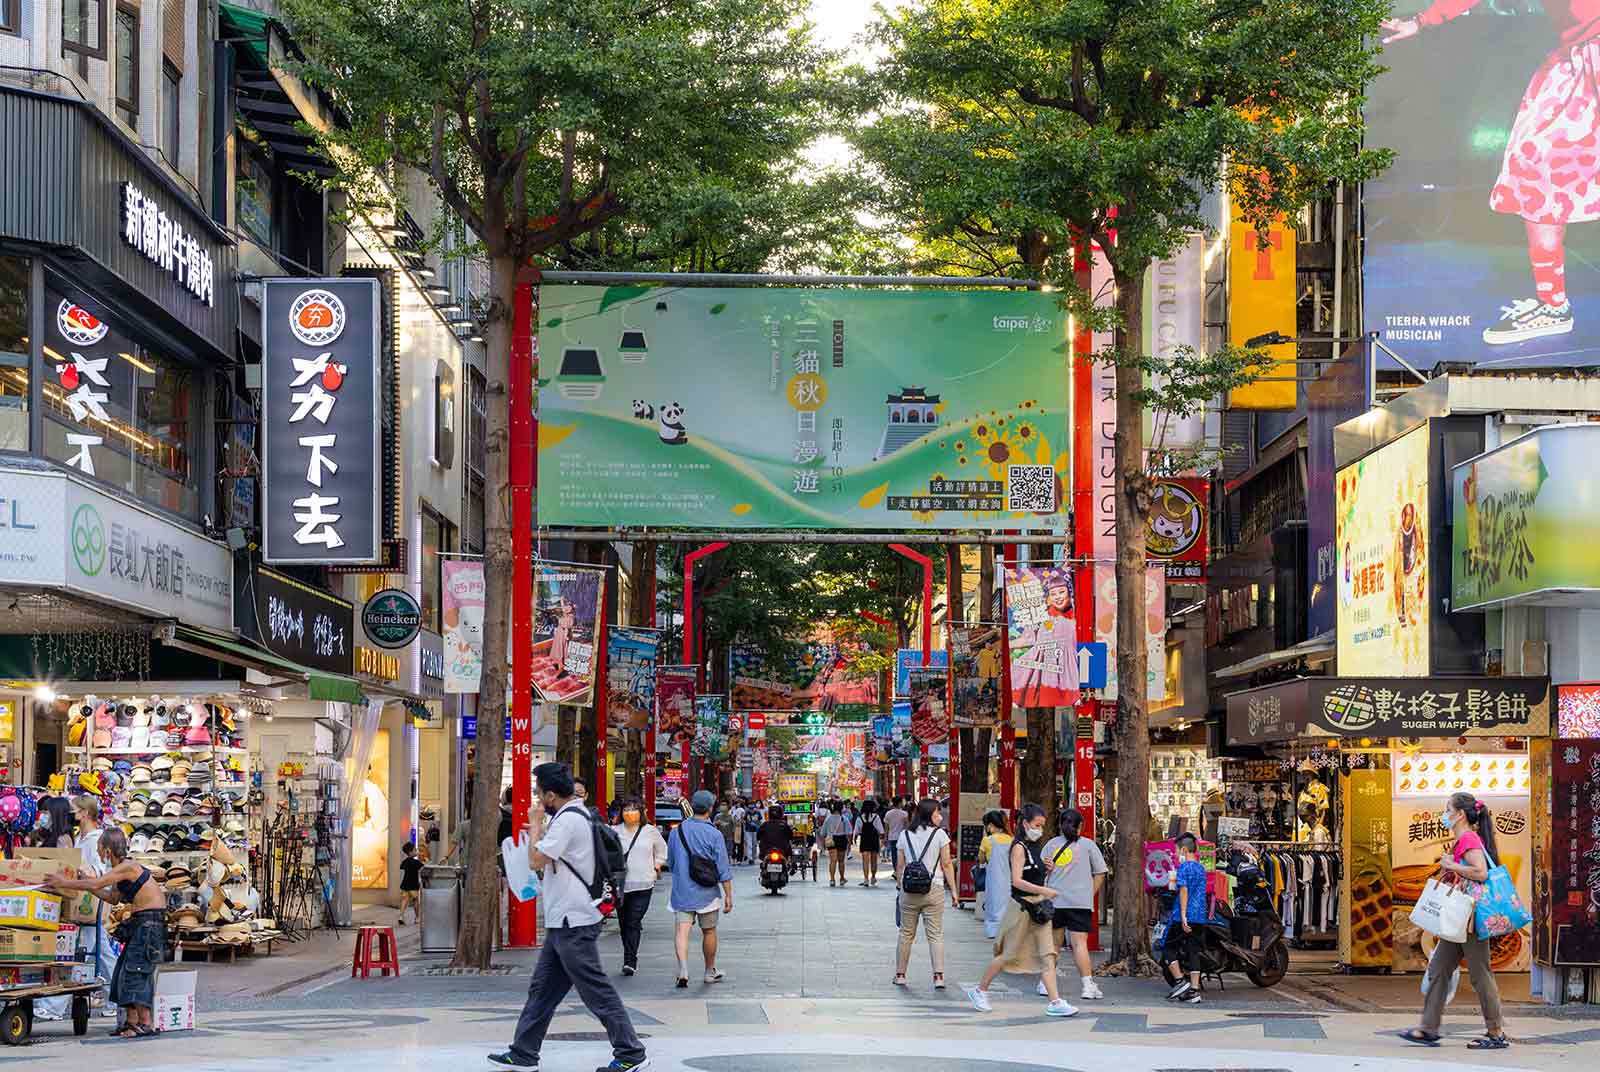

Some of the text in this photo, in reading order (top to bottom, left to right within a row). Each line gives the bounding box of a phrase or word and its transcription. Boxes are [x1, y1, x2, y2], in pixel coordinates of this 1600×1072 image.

[1385, 315, 1470, 326] TIERRA WHACK
[1386, 330, 1441, 341] MUSICIAN
[108, 520, 185, 597] 長虹大飯店
[366, 614, 417, 625] Heineken
[514, 719, 528, 731] W
[1401, 721, 1479, 730] SUGER WAFFLE
[514, 744, 530, 755] 16
[1003, 742, 1014, 752] W
[1077, 747, 1093, 759] 15
